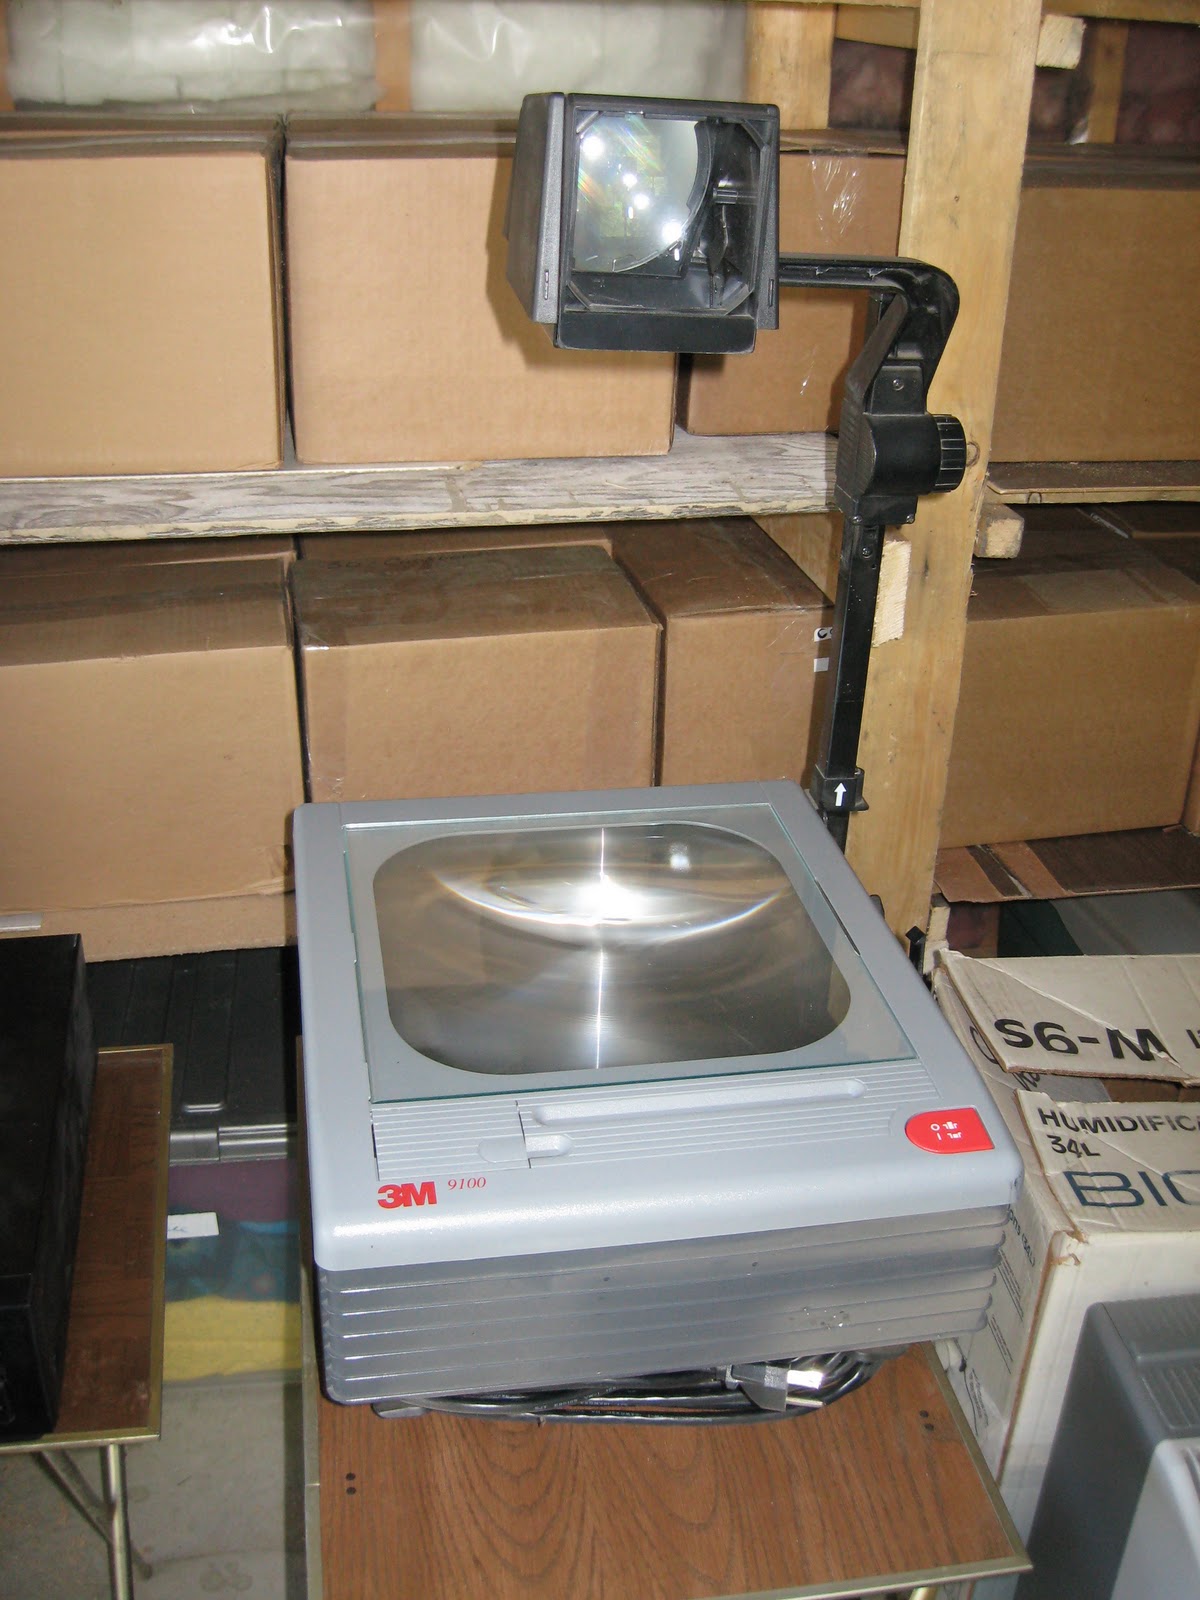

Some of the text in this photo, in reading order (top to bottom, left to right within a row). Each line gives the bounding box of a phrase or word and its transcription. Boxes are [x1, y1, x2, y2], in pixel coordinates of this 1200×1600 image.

[1046, 1134, 1101, 1158] 34L
[377, 1176, 487, 1209] 3M 9100
